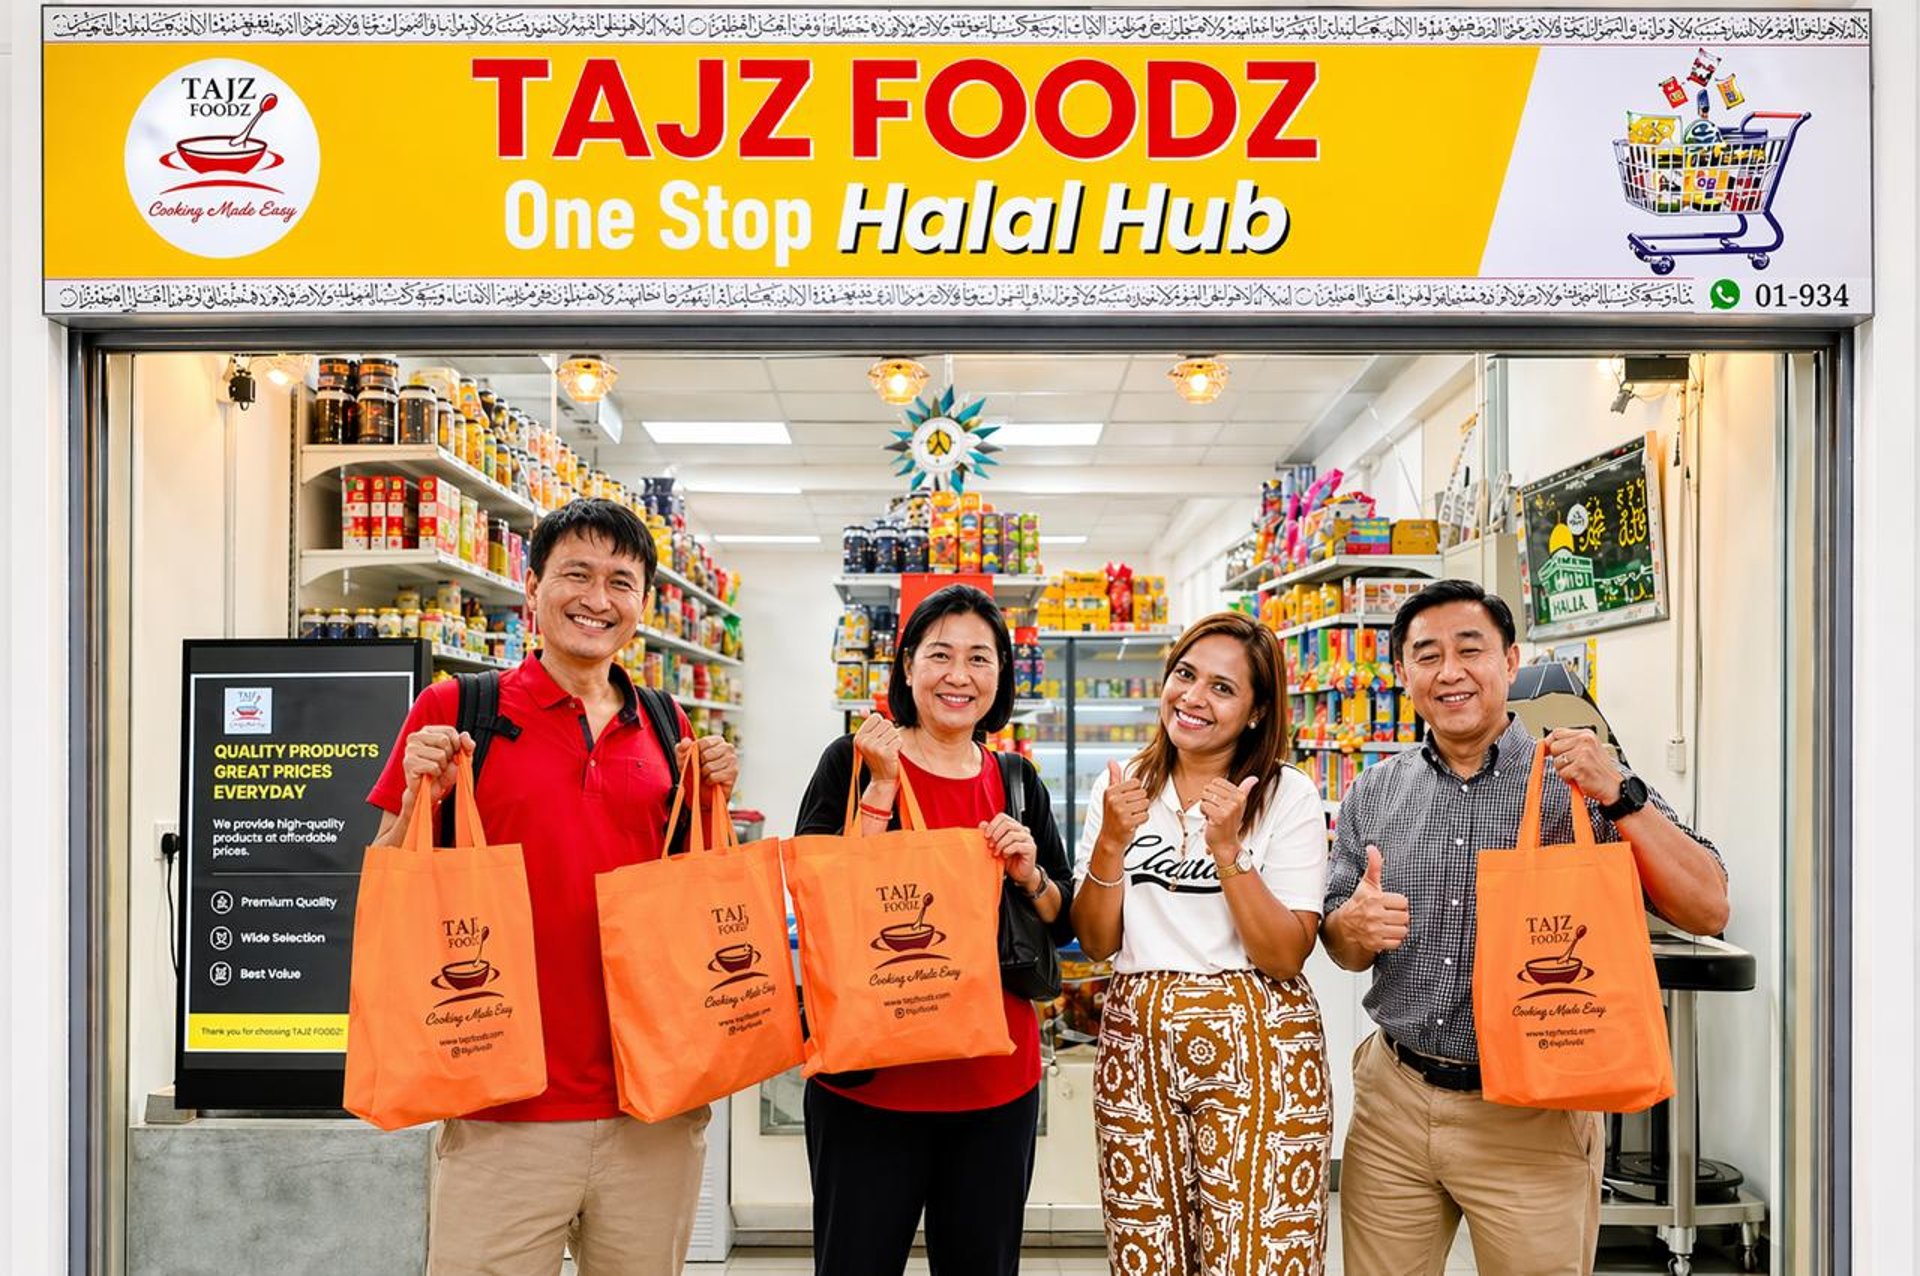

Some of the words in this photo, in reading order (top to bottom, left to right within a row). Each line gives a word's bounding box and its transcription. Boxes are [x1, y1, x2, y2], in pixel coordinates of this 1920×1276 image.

[182, 77, 256, 104] TAJZ
[190, 103, 251, 117] FOODZ
[472, 58, 813, 160] TAJZ
[851, 57, 1319, 161] FOODZ
[149, 201, 204, 223] Cooking
[207, 201, 256, 217] Made
[259, 201, 297, 223] Easy
[505, 179, 635, 250] One
[659, 179, 812, 267] Stop
[837, 180, 1085, 254] Halal
[1099, 180, 1291, 254] Hub
[1754, 284, 1849, 307] 01-934
[214, 744, 285, 759] QUALITY
[289, 744, 379, 758] PRODUCTS
[214, 764, 270, 779] GREAT
[273, 764, 333, 778] PRICES
[214, 785, 306, 799] EVERYDAY
[213, 818, 231, 829] We
[234, 818, 274, 831] provide
[277, 818, 345, 831] high-quality
[213, 832, 262, 845] products
[265, 833, 277, 842] at
[279, 832, 337, 843] affordable
[213, 845, 249, 859] prices.
[876, 883, 920, 901] TAJZ
[240, 896, 293, 907] Premium
[296, 896, 337, 910] Quality
[1526, 914, 1573, 934] TAJZ
[240, 932, 270, 943] Wide
[272, 932, 325, 943] Selection
[1530, 933, 1571, 945] FOODZ
[240, 968, 265, 979] Best
[268, 968, 301, 979] Value
[869, 973, 906, 988] Cooking
[907, 968, 937, 981] Made
[939, 966, 961, 980] Easy
[426, 1012, 463, 1028] Cooking
[465, 1007, 493, 1022] Made
[1512, 1005, 1547, 1020] Cooking
[1549, 1003, 1580, 1016] Made
[1582, 1002, 1606, 1018] Easy
[202, 1027, 224, 1035] Thank
[243, 1027, 254, 1035] for
